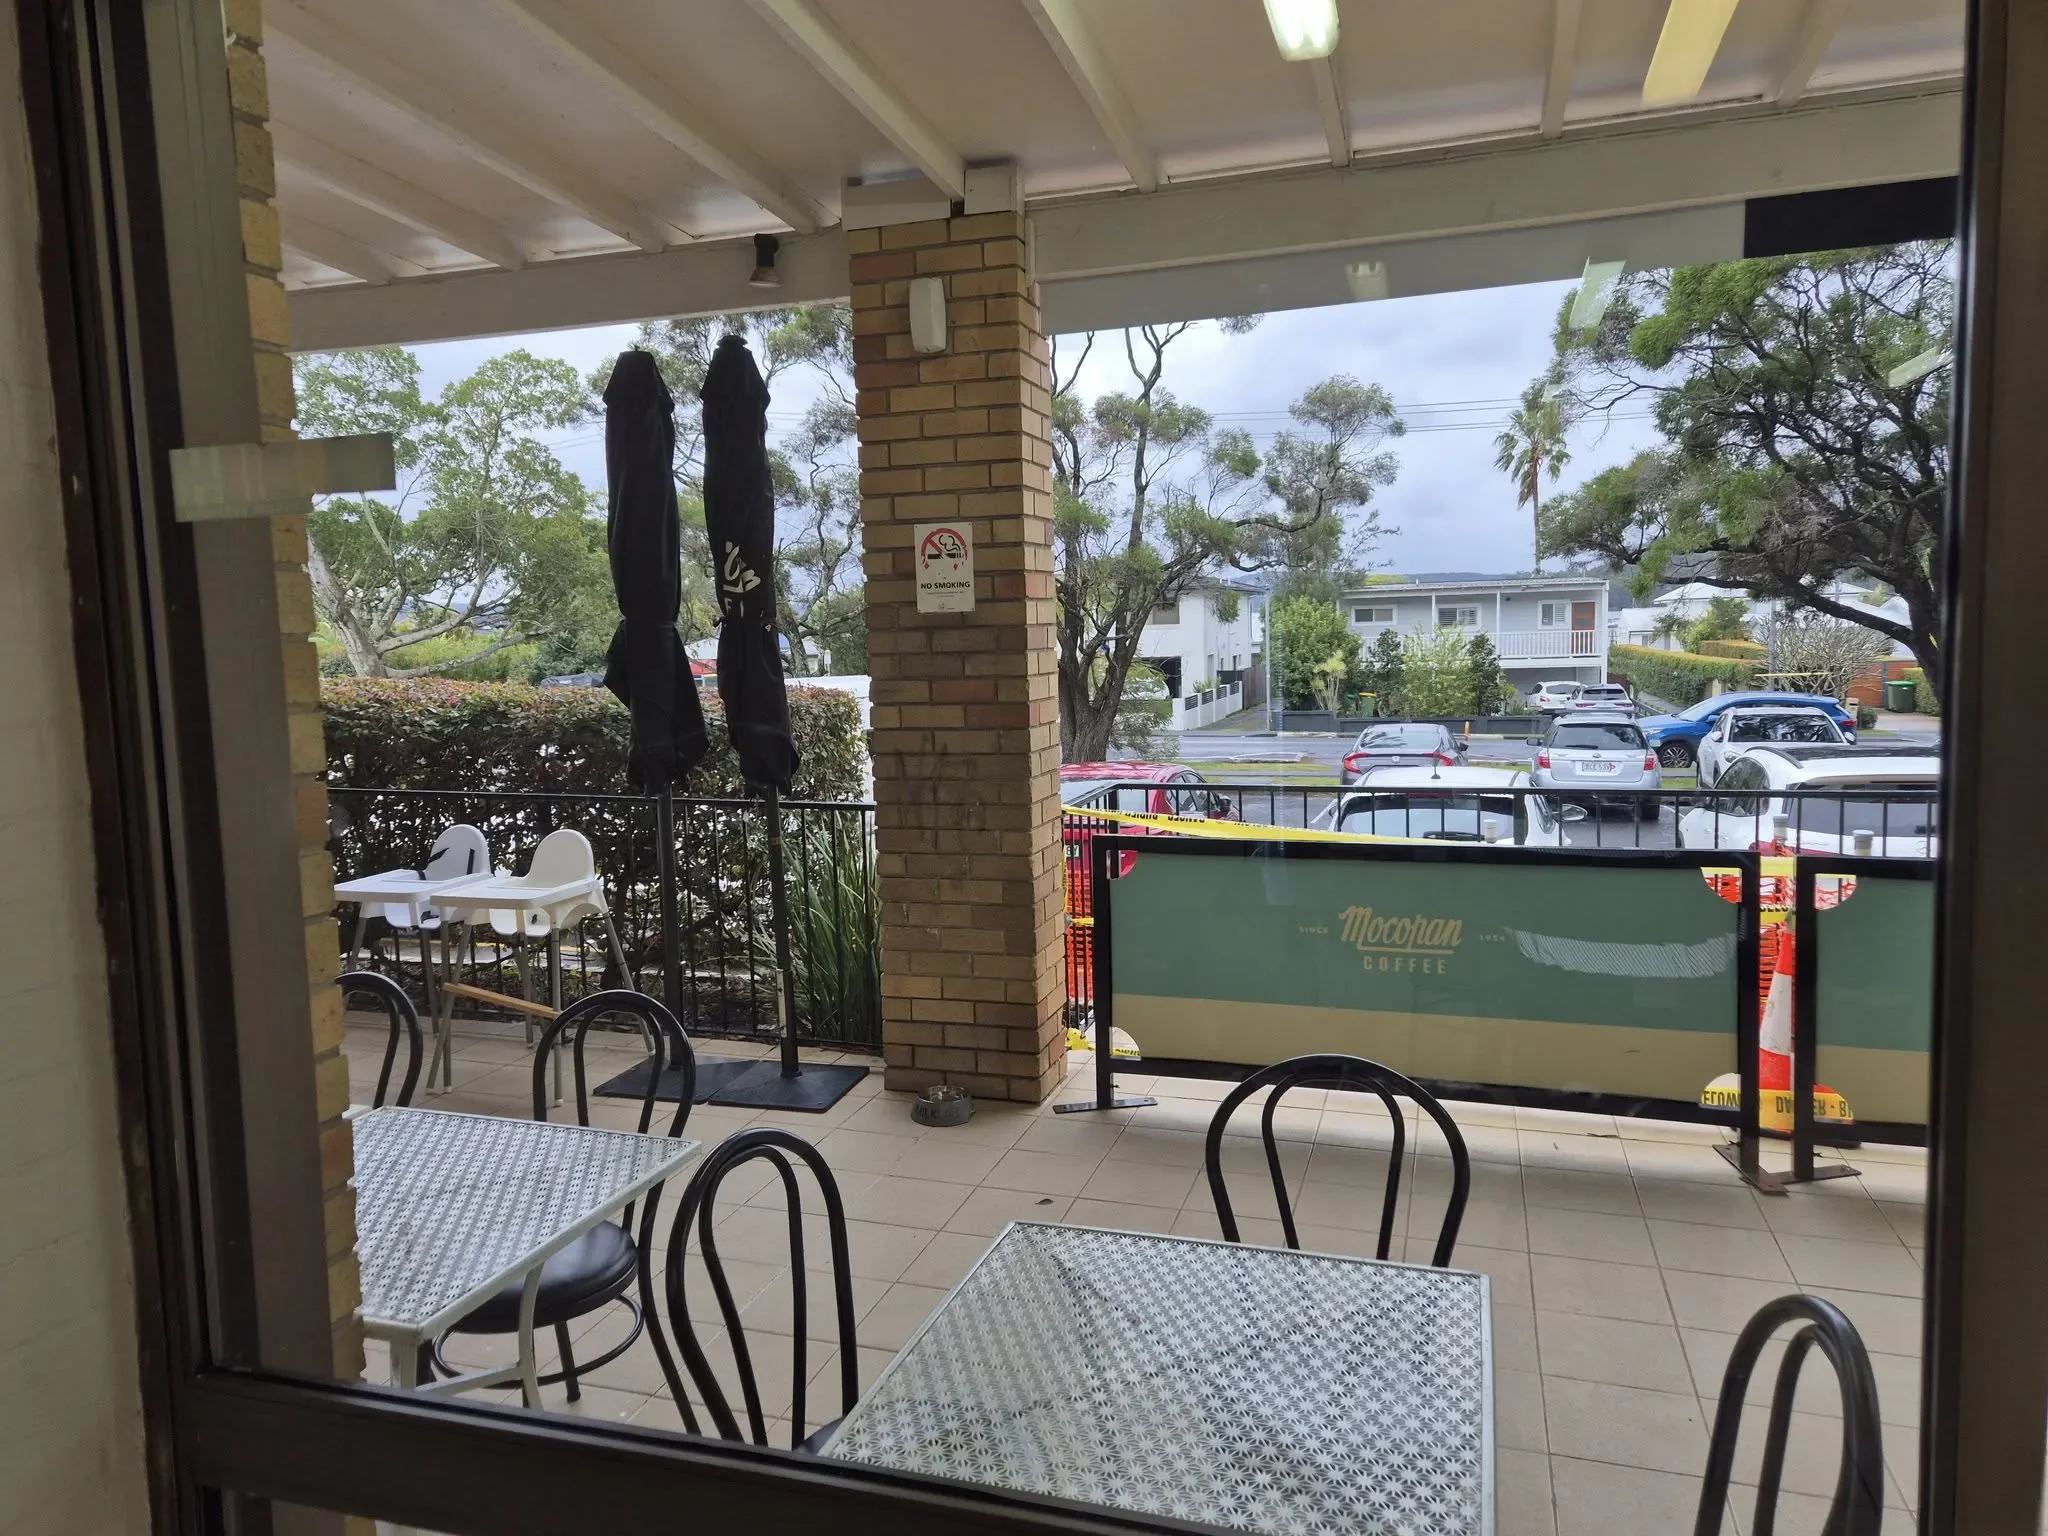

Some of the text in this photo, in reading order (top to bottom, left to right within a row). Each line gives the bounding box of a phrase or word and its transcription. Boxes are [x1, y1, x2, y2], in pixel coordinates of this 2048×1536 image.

[934, 581, 970, 589] SMOKING
[1299, 925, 1329, 935] SINCE
[1338, 905, 1462, 950] Mocopan
[1363, 955, 1447, 975] COFFEE
